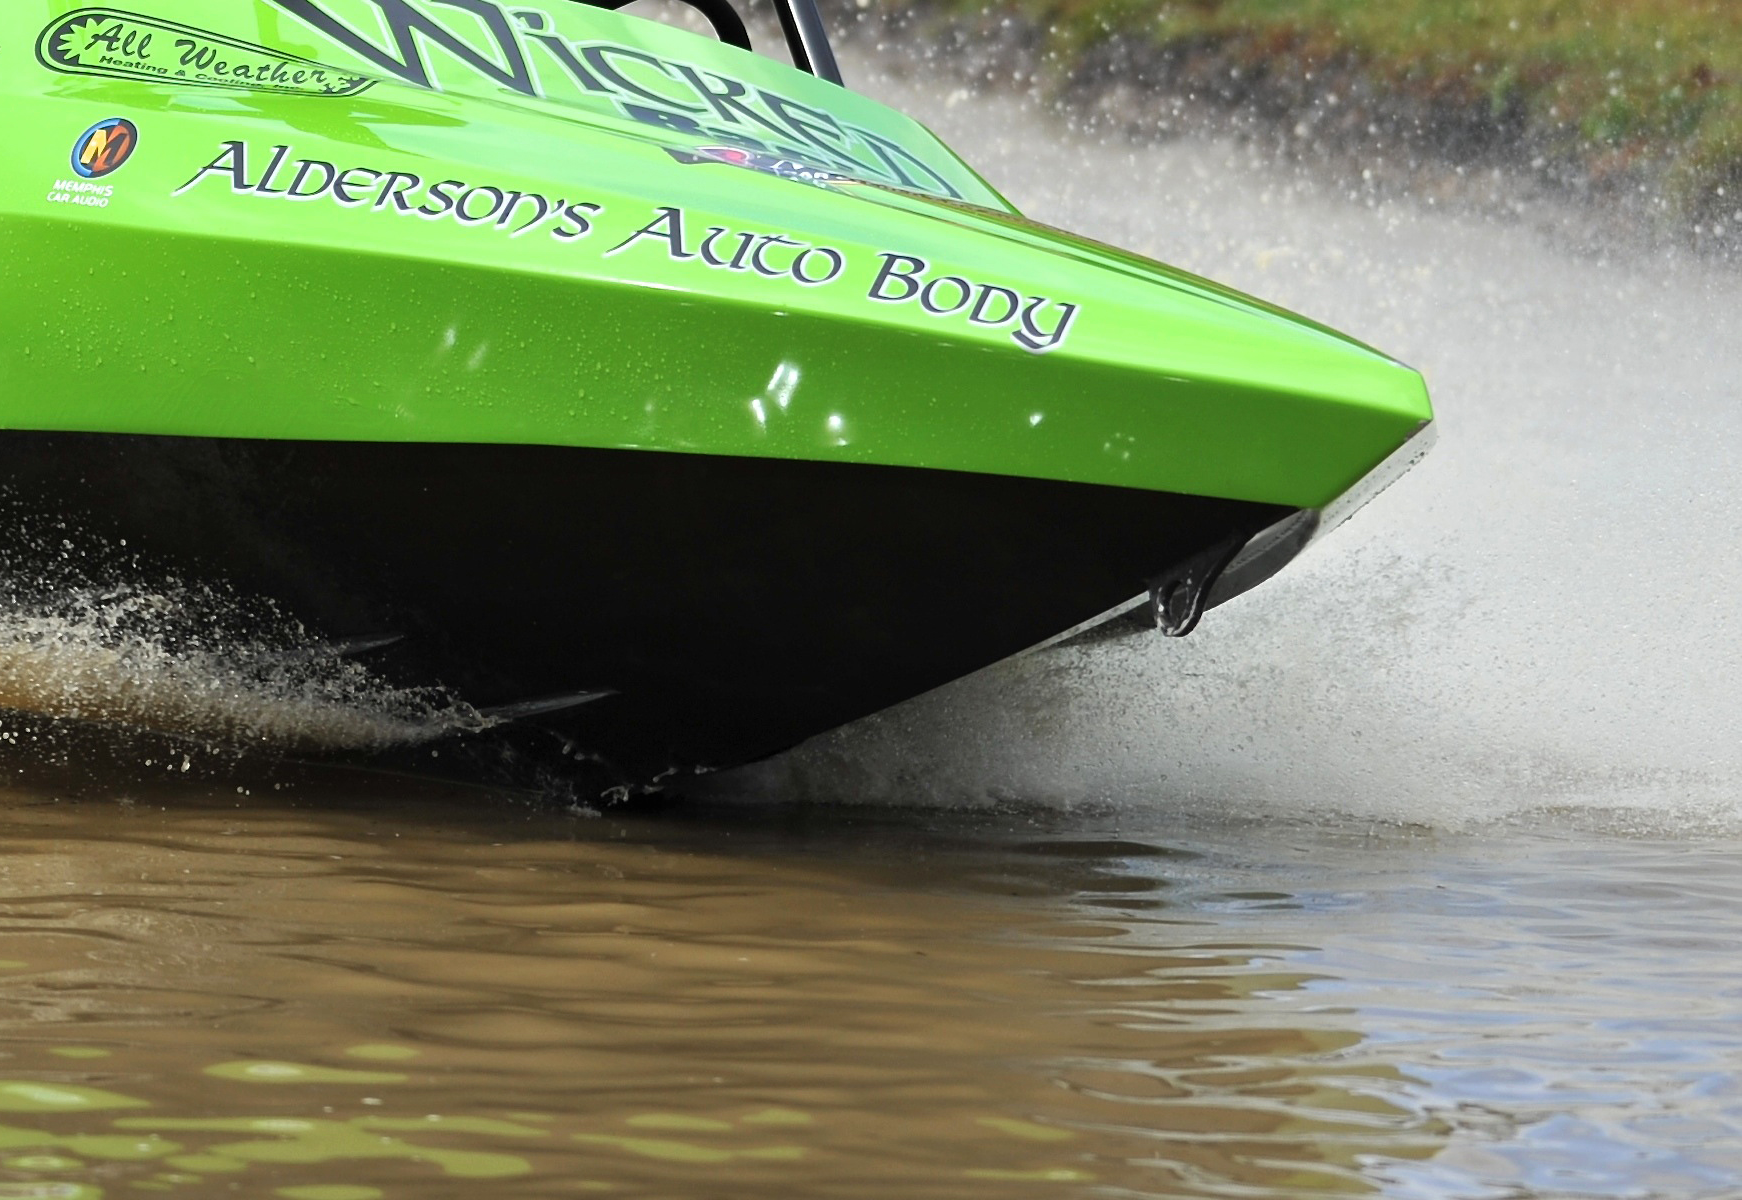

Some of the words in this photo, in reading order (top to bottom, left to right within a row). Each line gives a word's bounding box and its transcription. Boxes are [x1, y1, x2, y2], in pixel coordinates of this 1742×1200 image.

[84, 23, 152, 59] All
[174, 38, 327, 85] Weather
[98, 55, 168, 75] Heating
[52, 179, 114, 197] MEMPHIS
[46, 191, 71, 203] CAR
[72, 195, 109, 208] AUDIO
